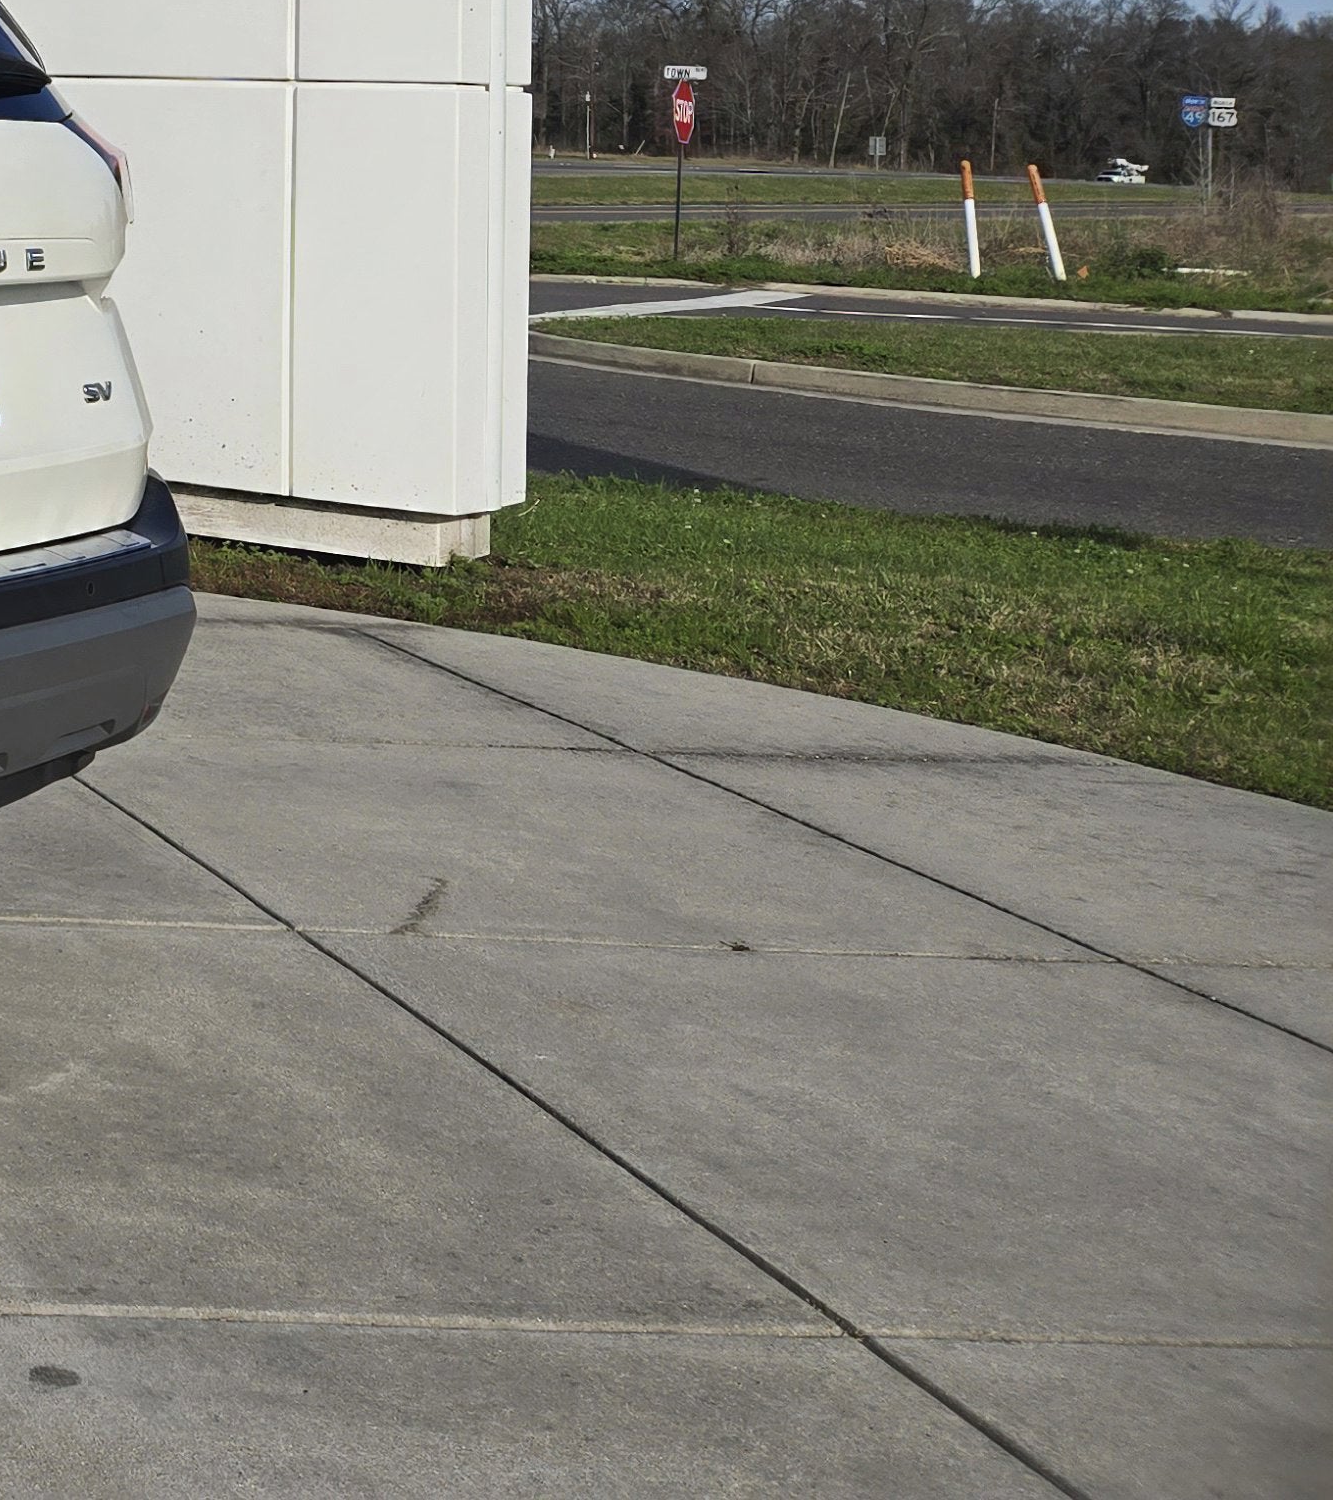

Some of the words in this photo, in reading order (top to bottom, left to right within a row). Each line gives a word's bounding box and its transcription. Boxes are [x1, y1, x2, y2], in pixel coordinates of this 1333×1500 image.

[666, 67, 691, 78] TOWN
[675, 99, 694, 124] STOP
[1185, 111, 1205, 123] 49
[1211, 111, 1235, 122] 167
[83, 381, 112, 403] SV
